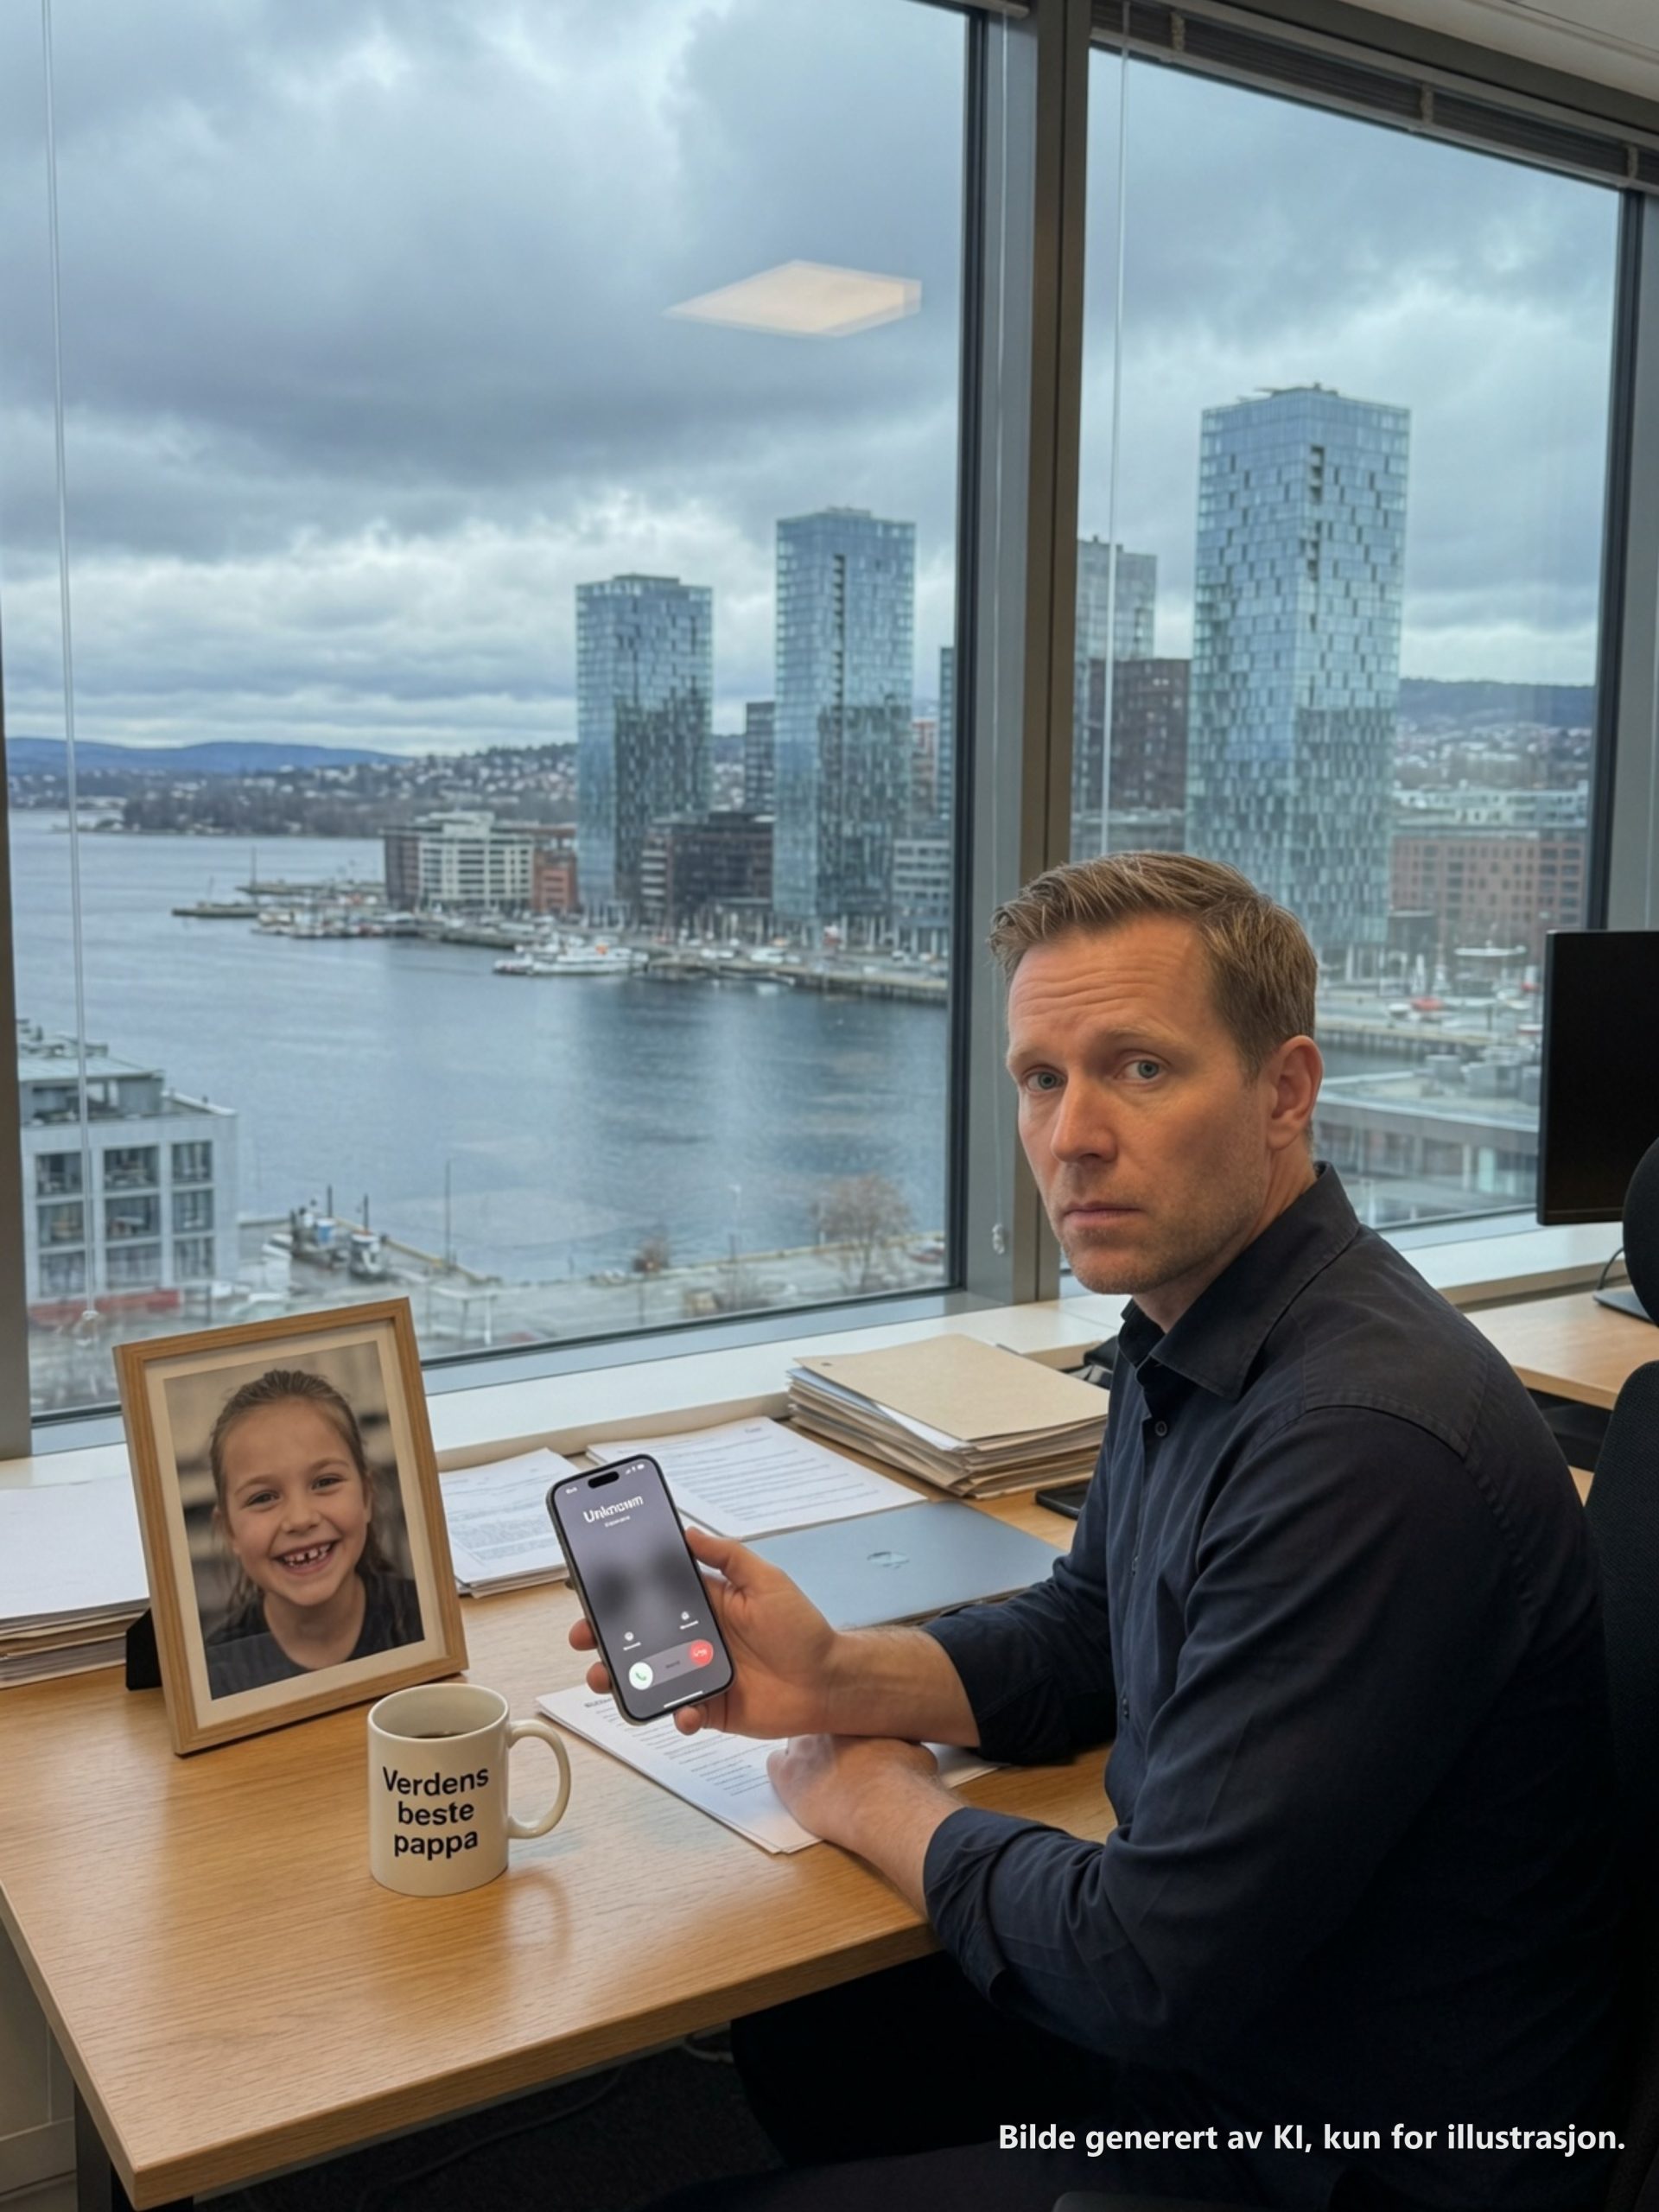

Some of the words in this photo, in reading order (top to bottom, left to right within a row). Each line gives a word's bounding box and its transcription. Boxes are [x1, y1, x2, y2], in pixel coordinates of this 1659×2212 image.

[383, 1766, 489, 1796] Verdens
[398, 1801, 474, 1826] beste
[394, 1831, 478, 1861] pappa
